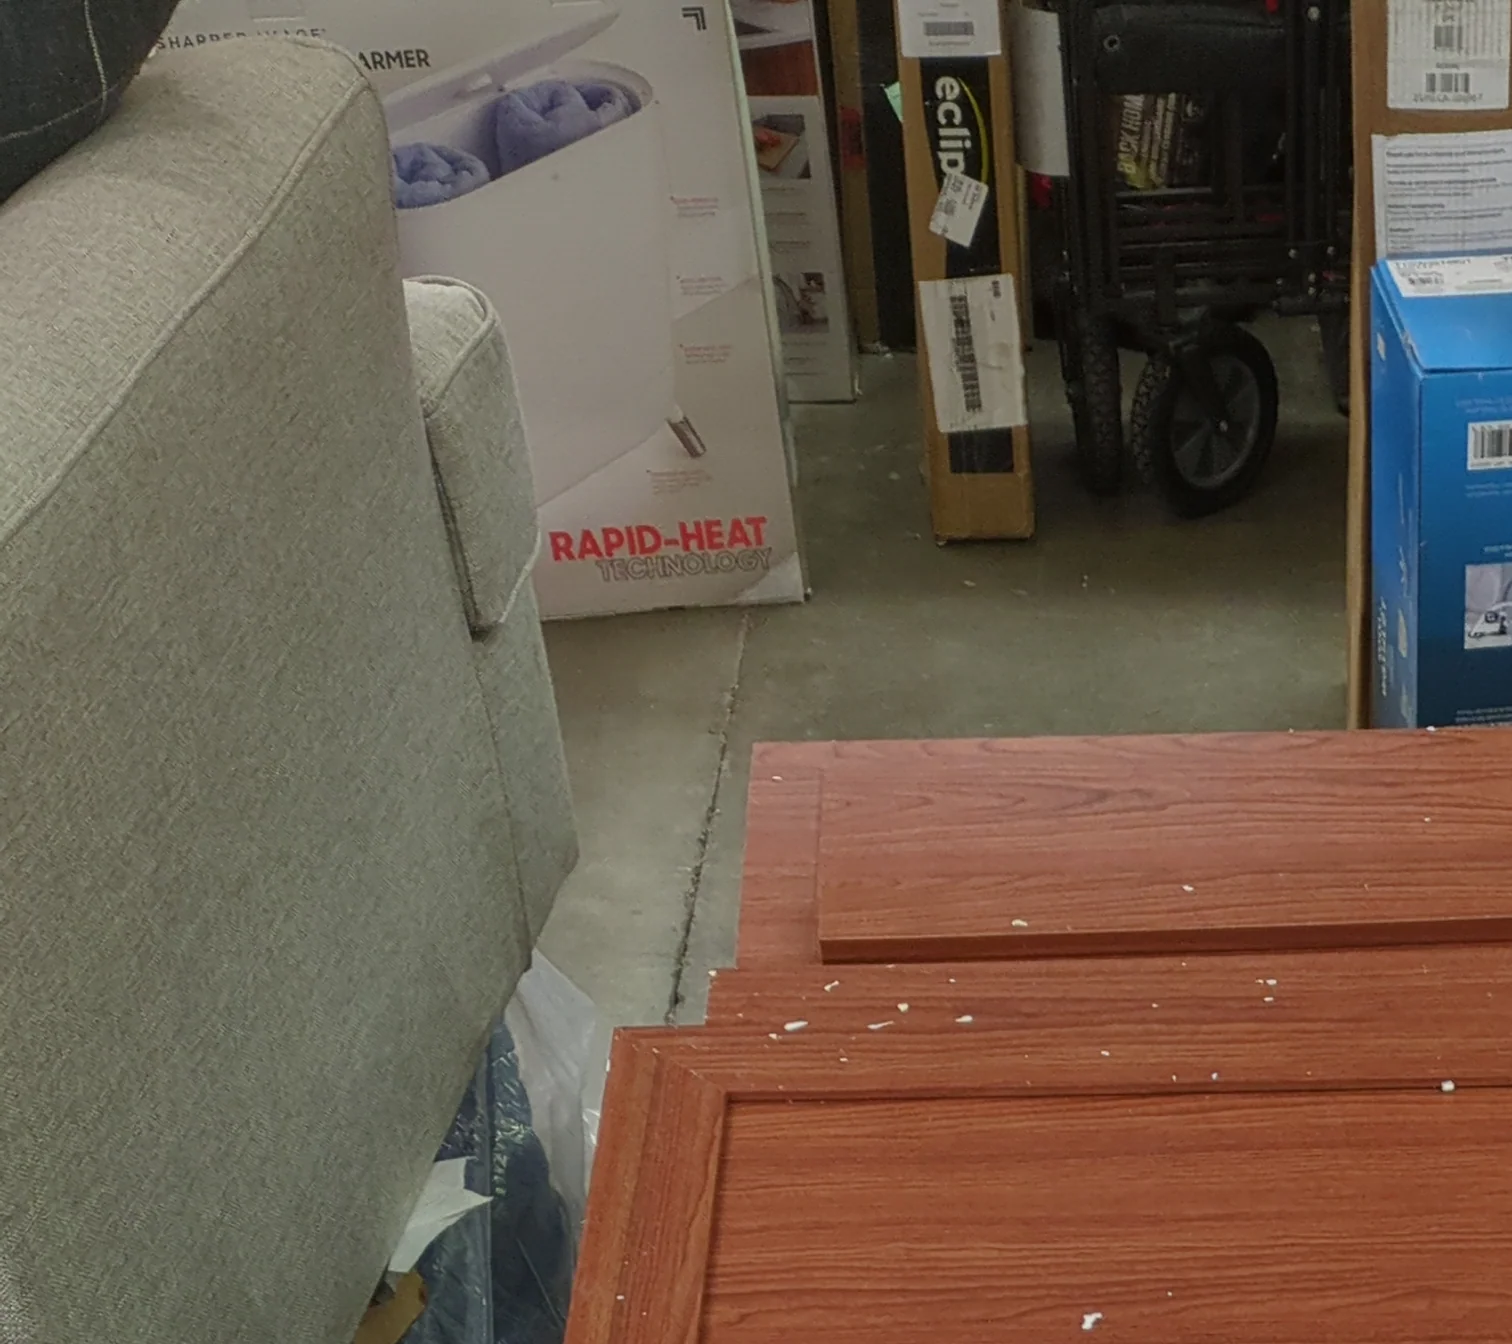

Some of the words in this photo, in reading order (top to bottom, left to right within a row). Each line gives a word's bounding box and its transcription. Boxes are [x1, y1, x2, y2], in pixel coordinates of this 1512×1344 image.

[357, 48, 431, 71] ARMER
[935, 76, 972, 175] eclip
[548, 516, 768, 562] RAPID-HEAT
[595, 547, 773, 583] TECHNOLOGY
